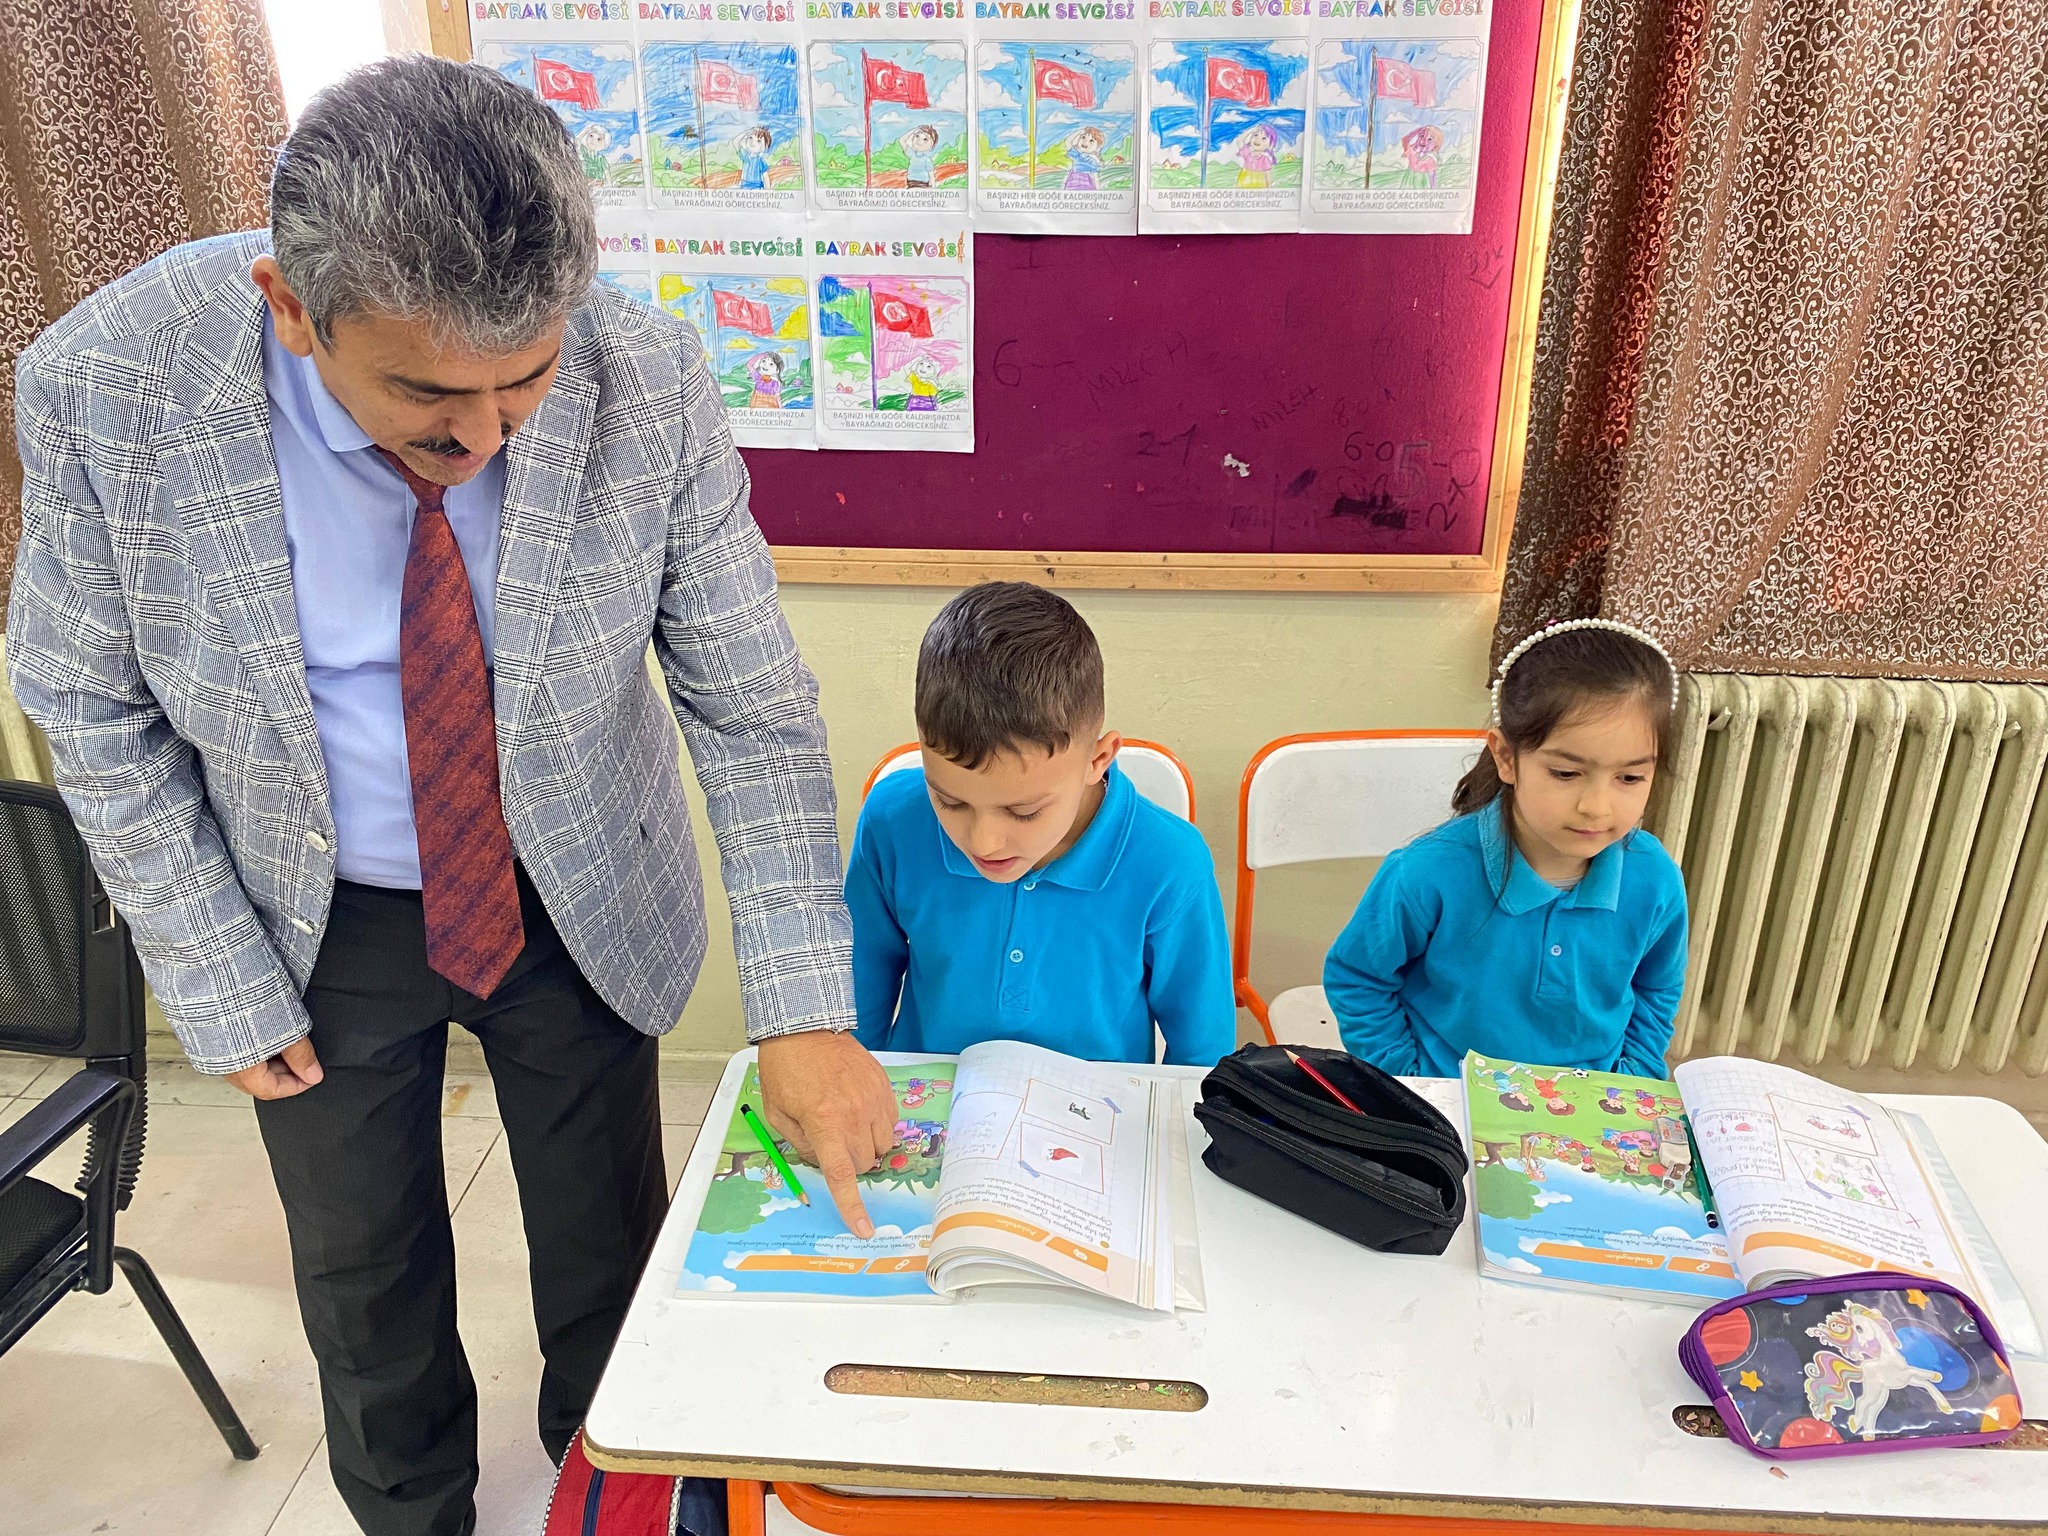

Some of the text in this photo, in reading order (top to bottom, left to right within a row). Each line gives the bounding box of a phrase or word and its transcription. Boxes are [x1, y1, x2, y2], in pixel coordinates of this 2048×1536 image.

[475, 0, 629, 19] BAYRAK SEVGİSİ
[639, 0, 795, 20] BAYRAK SEVGİSİ
[806, 1, 881, 18] BAYRAK
[975, 1, 1051, 18] BAYRAK
[1149, 0, 1226, 17] BAYRAK
[1319, 0, 1397, 17] BAYRAK
[655, 234, 803, 255] BAYRAK SEVGİSİ
[815, 236, 966, 259] BAYRAK SEVGİSİ
